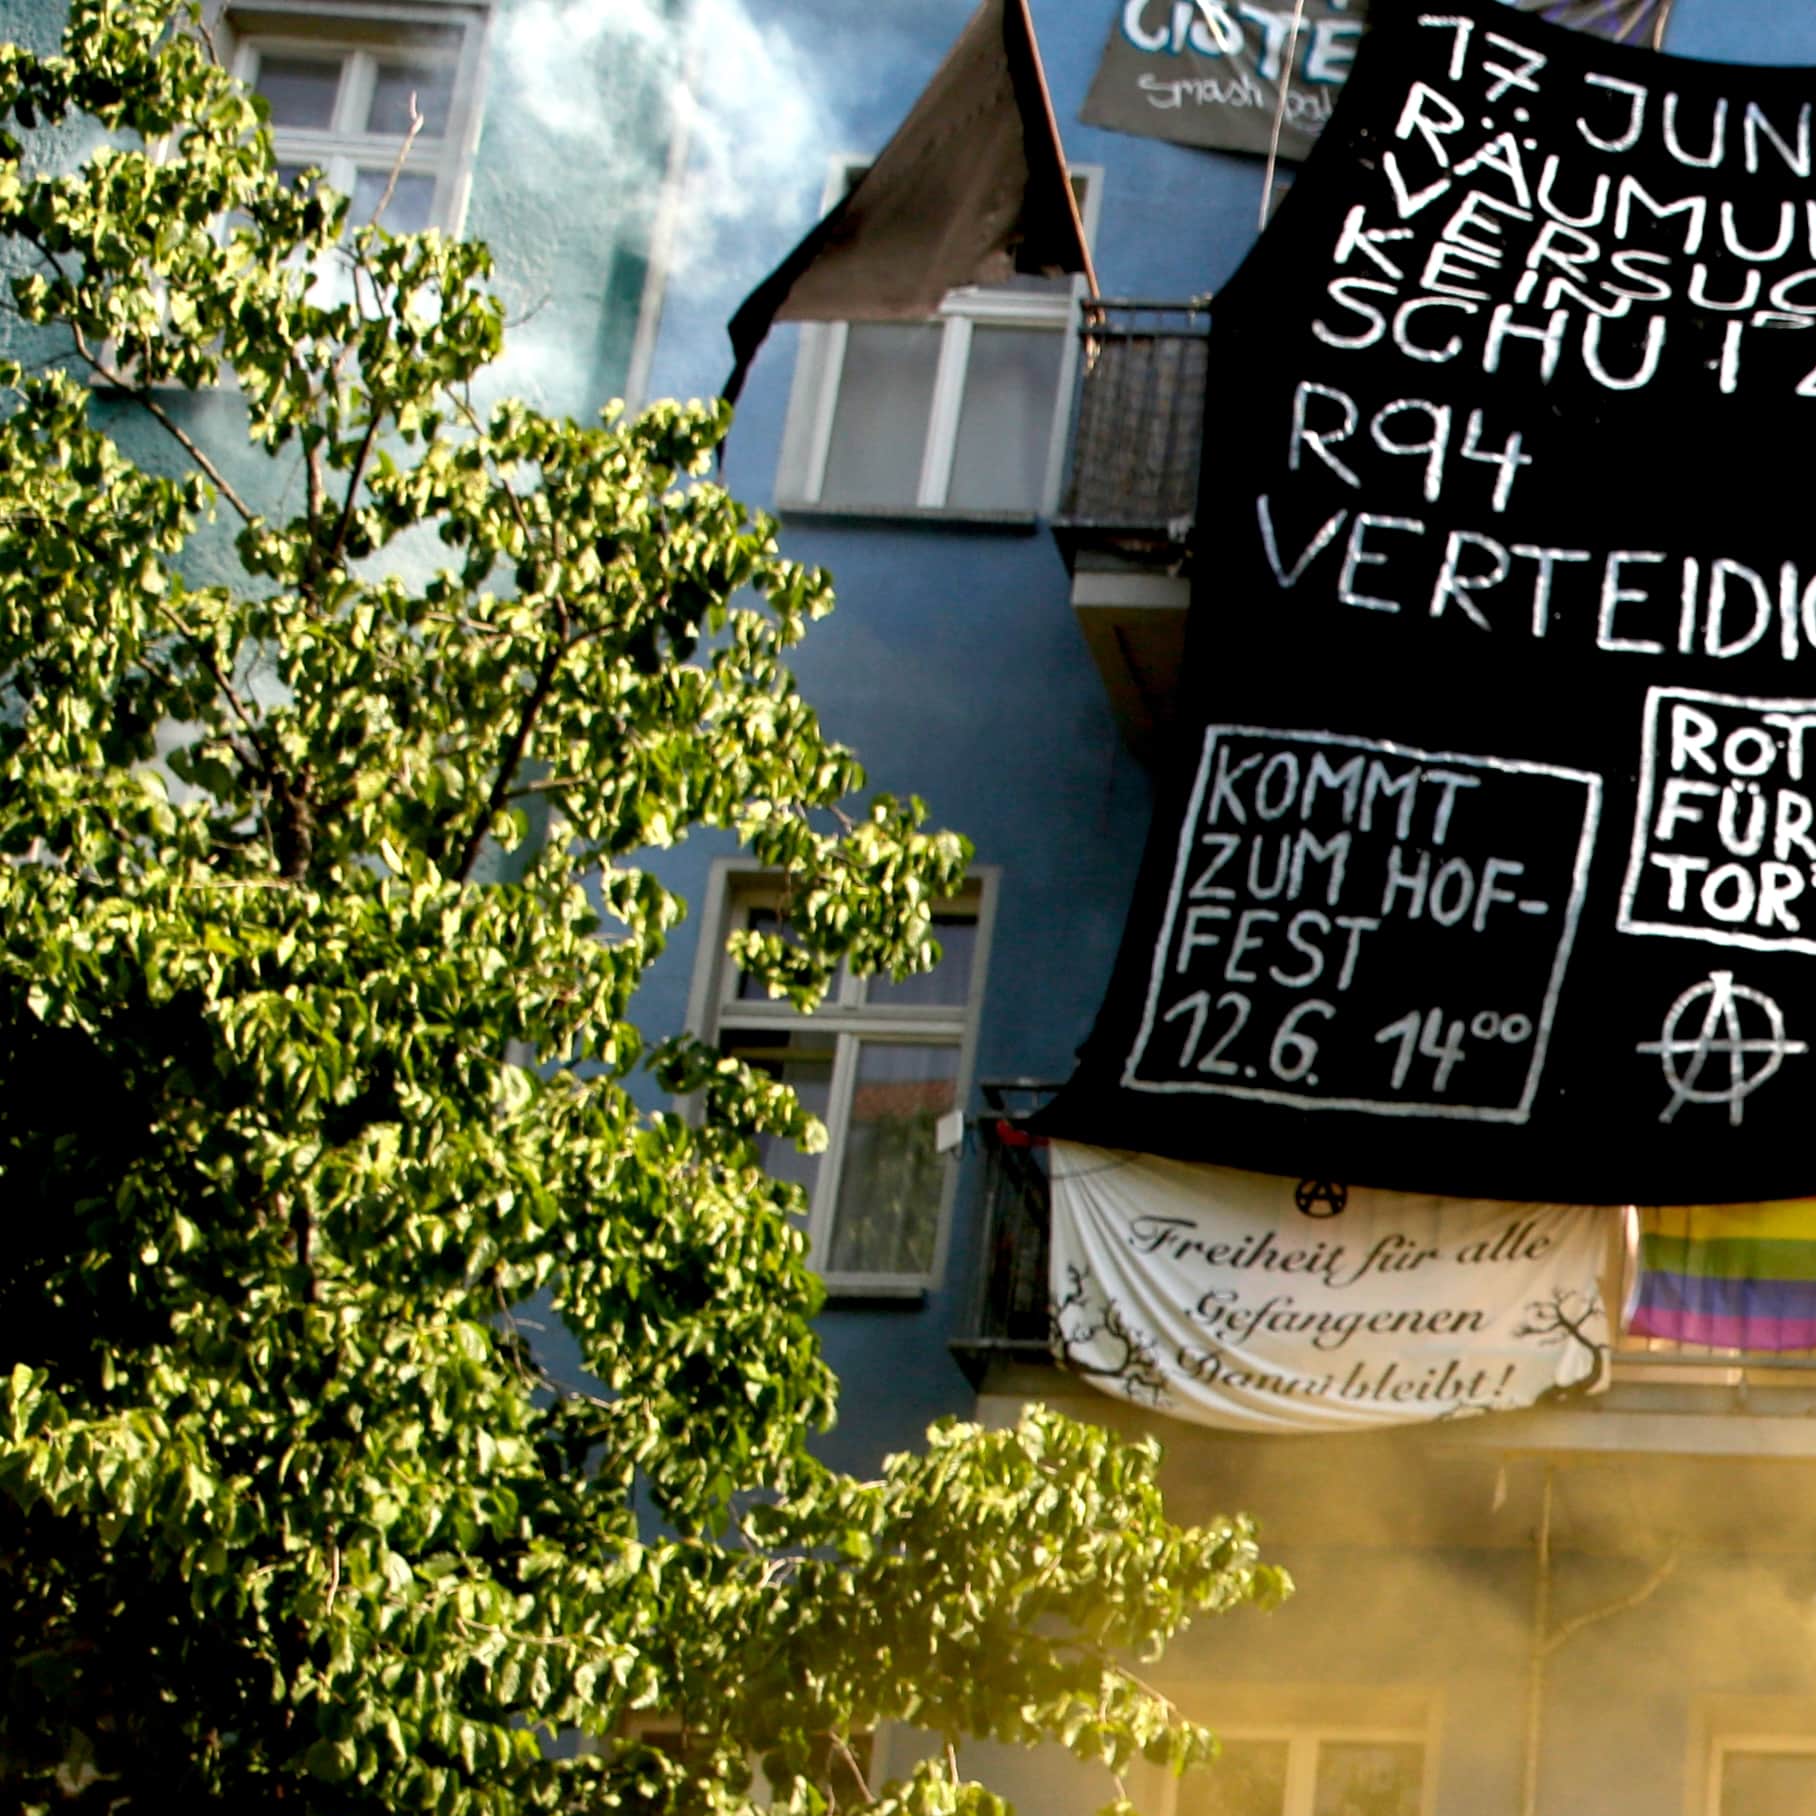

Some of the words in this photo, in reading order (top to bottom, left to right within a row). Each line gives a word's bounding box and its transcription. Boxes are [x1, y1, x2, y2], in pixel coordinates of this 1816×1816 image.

[1334, 205, 1630, 316] KEIN
[1291, 381, 1530, 513] R94
[1209, 745, 1480, 845] KOMMT
[1192, 832, 1351, 906] ZUM
[1382, 850, 1548, 930] HOF-
[1177, 906, 1380, 988] FEST
[1128, 1216, 1340, 1274] Freiheit
[1322, 1232, 1437, 1287] für
[1455, 1221, 1551, 1268] alle
[1183, 1289, 1486, 1351] Gefangenen
